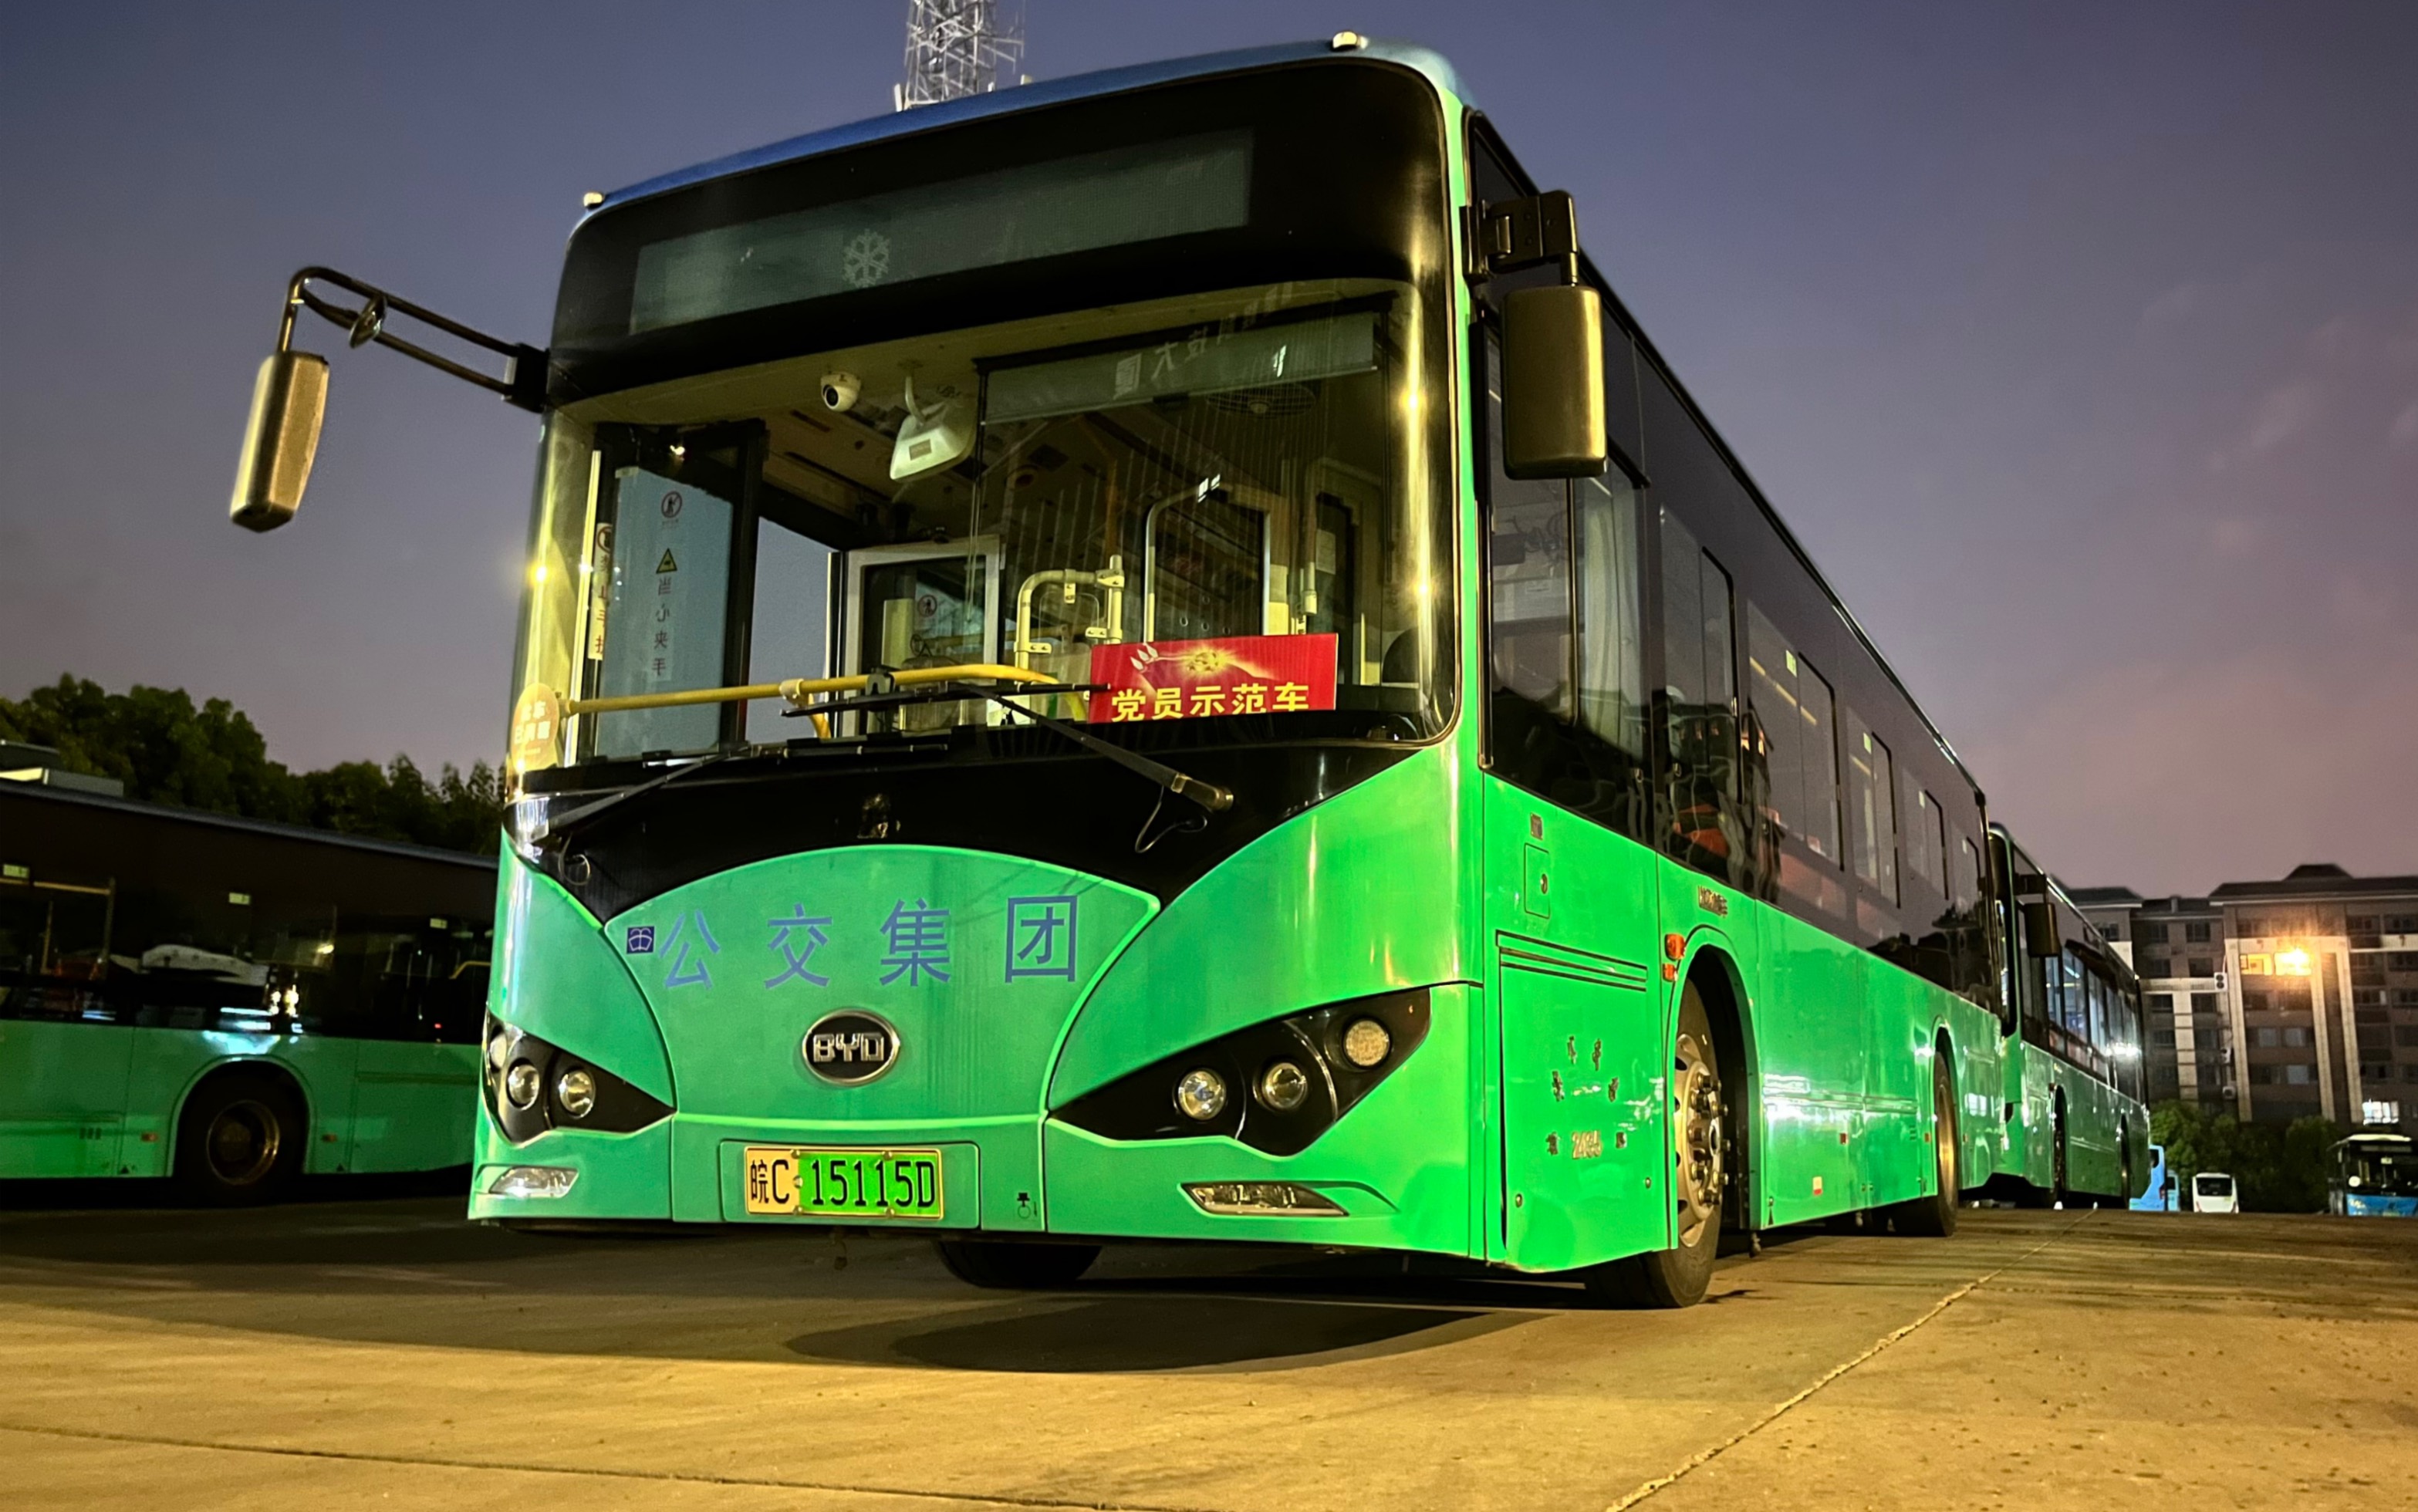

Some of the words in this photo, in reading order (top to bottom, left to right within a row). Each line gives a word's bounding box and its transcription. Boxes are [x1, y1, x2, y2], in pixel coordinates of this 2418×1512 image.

[1111, 682, 1309, 722] 党员示范车
[659, 895, 1078, 990] 公交集团
[812, 1031, 885, 1063] BYD
